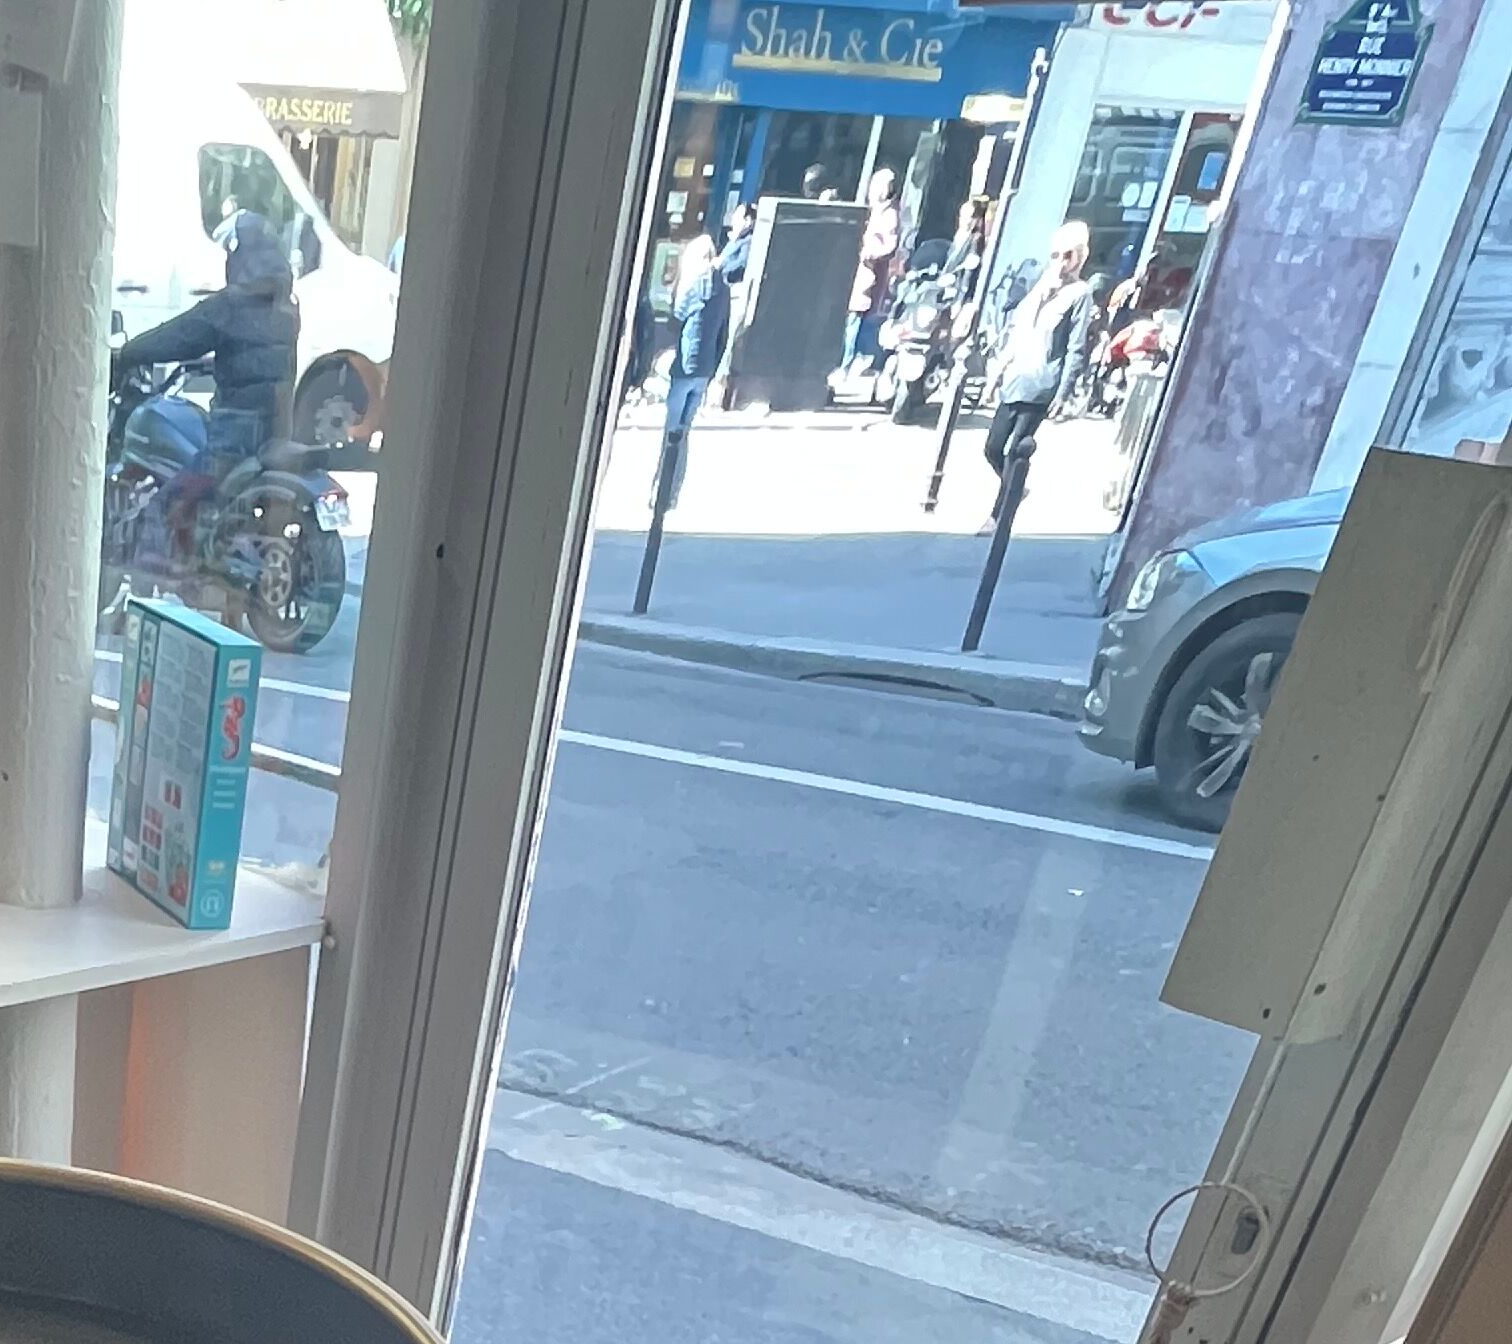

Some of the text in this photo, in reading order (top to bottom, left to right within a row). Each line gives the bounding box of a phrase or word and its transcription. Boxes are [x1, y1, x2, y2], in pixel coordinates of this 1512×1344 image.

[740, 4, 944, 68] Shah & Cie
